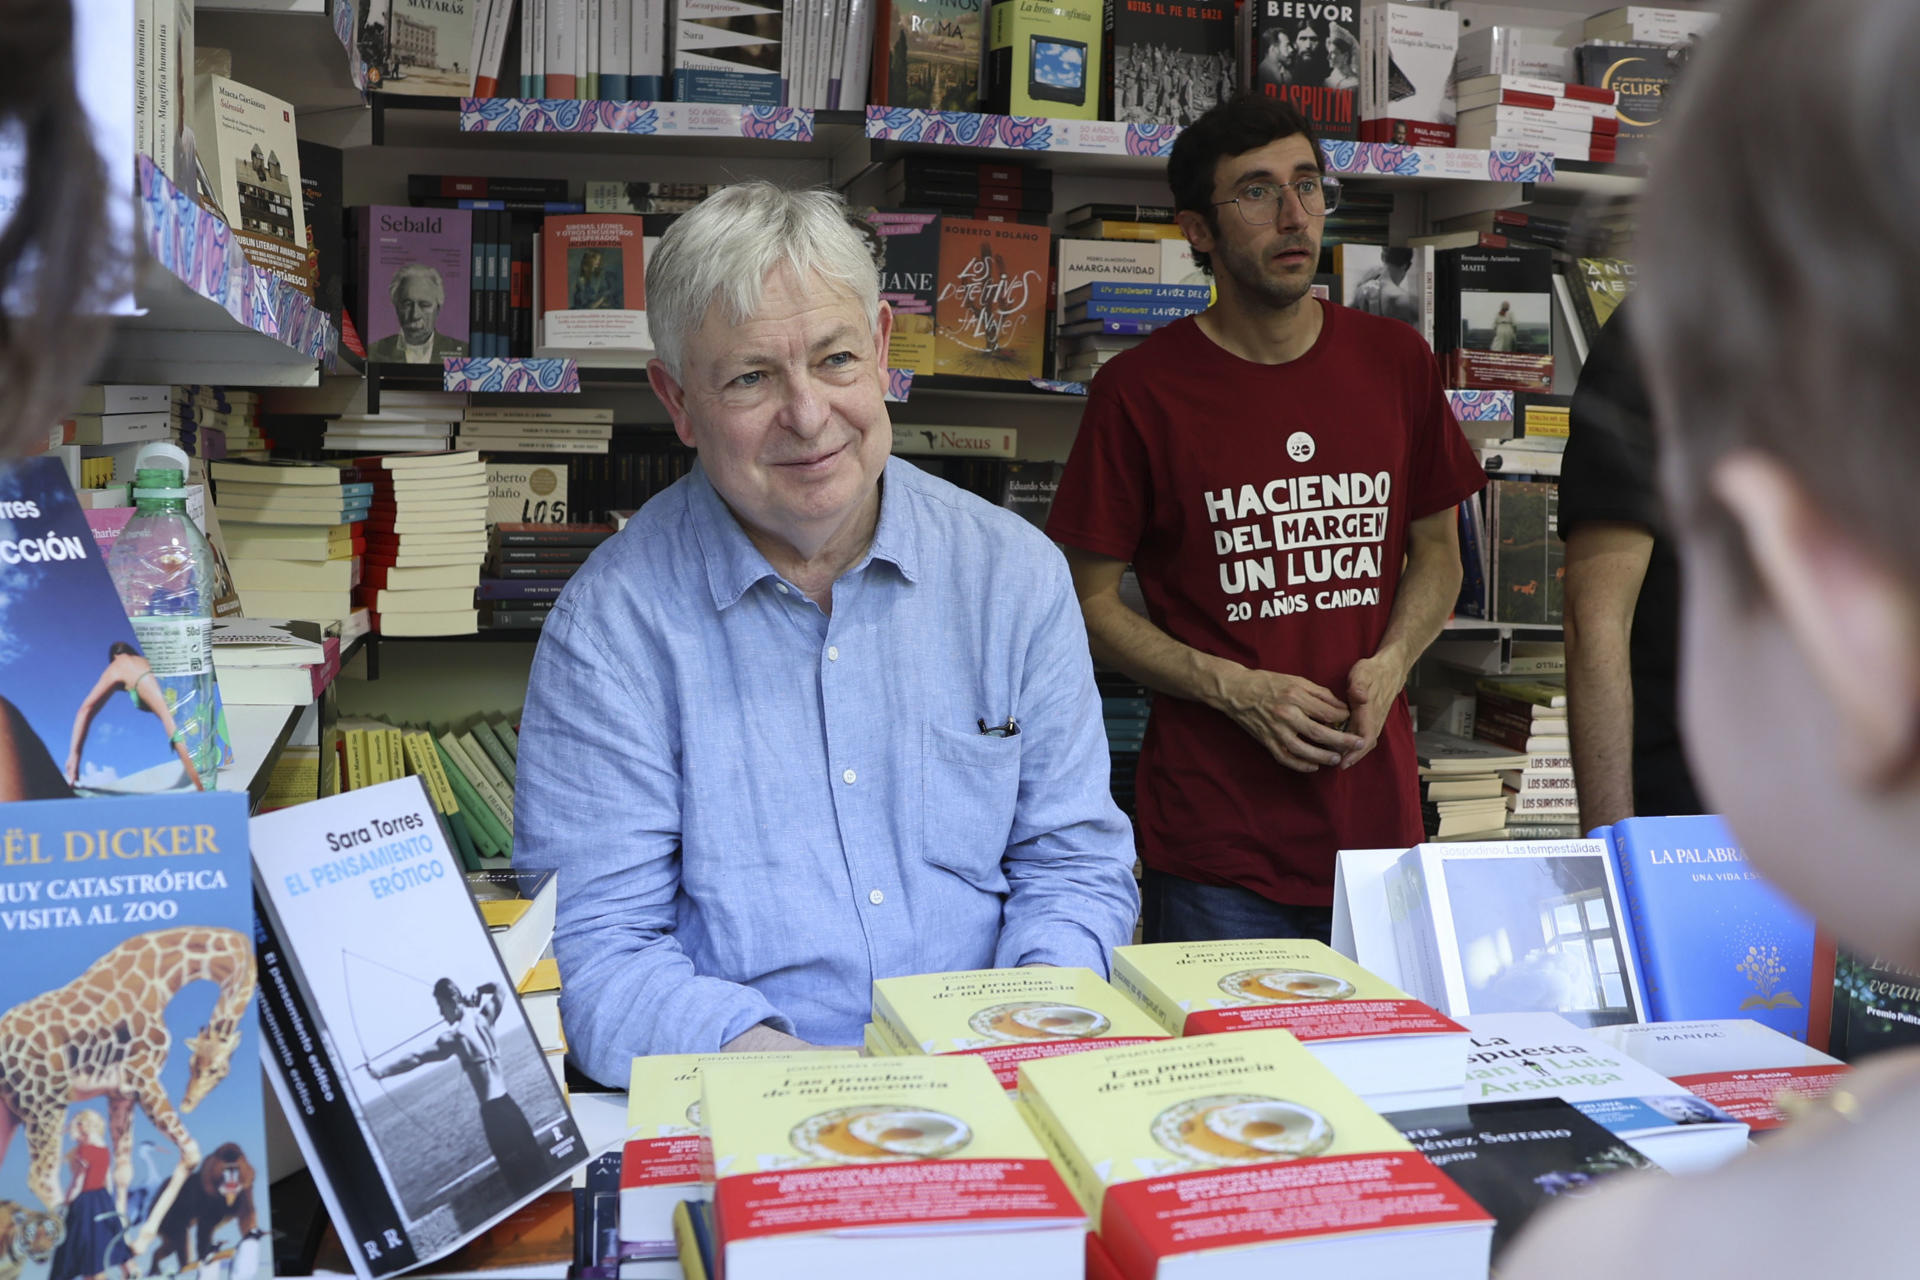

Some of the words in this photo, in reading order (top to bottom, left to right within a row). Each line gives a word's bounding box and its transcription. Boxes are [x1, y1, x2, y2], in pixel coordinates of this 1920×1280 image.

[1127, 1, 1152, 14] NOTAS
[1155, 4, 1166, 15] AL
[1169, 6, 1184, 17] PIE
[1187, 7, 1198, 19] DE
[1267, 0, 1353, 22] BEEVOR
[136, 19, 146, 67] humanitas
[683, 31, 704, 40] Sara
[159, 24, 167, 73] humanitas
[1414, 128, 1429, 136] PAUL
[1430, 129, 1451, 139] AUSTER
[380, 214, 443, 234] Sebald
[945, 226, 992, 237] ROBERTO
[995, 228, 1039, 242] BOLAÑO
[1068, 263, 1111, 273] AMARGA
[1112, 265, 1155, 276] NAVIDAD
[1461, 264, 1487, 273] MAITE
[879, 272, 933, 291] JANE
[1156, 288, 1168, 297] LA
[1187, 288, 1202, 299] DEL
[1152, 307, 1164, 316] LA
[940, 431, 992, 450] Nexus
[1292, 444, 1311, 456] 20
[485, 471, 528, 484] oberto
[1009, 481, 1039, 491] Eduardo
[486, 486, 522, 499] olaño
[1204, 471, 1392, 523] HACIENDO
[521, 499, 567, 524] LOS
[1213, 523, 1273, 556] DEL
[1281, 511, 1385, 546] MARGEN
[0, 530, 88, 565] CCIÓN
[1218, 556, 1277, 595] UN
[1225, 602, 1253, 622] 20
[1259, 590, 1309, 619] AÑOS
[1531, 758, 1544, 769] LOS
[1544, 757, 1572, 769] SURCOS
[1527, 778, 1541, 790] LOS
[1541, 778, 1570, 790] SURCOS
[1522, 798, 1536, 810] LOS
[326, 826, 372, 852] Sara
[370, 812, 425, 839] Torres
[3, 828, 53, 866] ËL
[64, 824, 220, 863] DICKER
[1507, 845, 1526, 855] Las
[1526, 843, 1602, 855] tempestálidas
[1650, 849, 1674, 865] LA
[1675, 847, 1750, 864] PALABRA
[283, 871, 311, 897] EL
[310, 833, 433, 889] PENSAMIENTO
[46, 868, 229, 900] CATASTRÓFICA
[369, 859, 445, 900] ERÓTICO
[1692, 873, 1714, 882] UNA
[1716, 872, 1741, 881] VIDA
[2, 907, 82, 931] VISITA
[87, 904, 118, 925] AL
[123, 899, 180, 923] ZOO
[264, 951, 277, 967] El
[1175, 958, 1198, 966] de
[1230, 953, 1312, 963] inocencia
[1184, 950, 1214, 959] Las
[1220, 948, 1289, 958] pruebas
[933, 992, 953, 1000] de
[961, 989, 985, 997] mi
[989, 985, 1075, 996] inocencia
[945, 983, 976, 992] Las
[982, 979, 1053, 990] pruebas
[267, 965, 313, 1053] pensamiento
[1867, 1006, 1897, 1021] Premio
[1469, 1036, 1511, 1048] La
[1655, 1031, 1727, 1042] MANIAC
[1111, 1064, 1151, 1080] Las
[1157, 1054, 1246, 1074] pruebas
[1545, 1056, 1621, 1071] Luis
[307, 1054, 335, 1103] erótico
[784, 1078, 822, 1088] Las
[830, 1074, 924, 1087] pruebas
[1098, 1081, 1128, 1094] de
[1133, 1076, 1162, 1088] mi
[1168, 1062, 1276, 1083] inocencia
[1480, 1070, 1624, 1098] Arsuaga
[289, 1067, 316, 1116] erótico
[763, 1088, 792, 1098] de
[799, 1086, 829, 1096] mi
[837, 1081, 949, 1093] inocencia
[1478, 1127, 1573, 1145] Serrano
